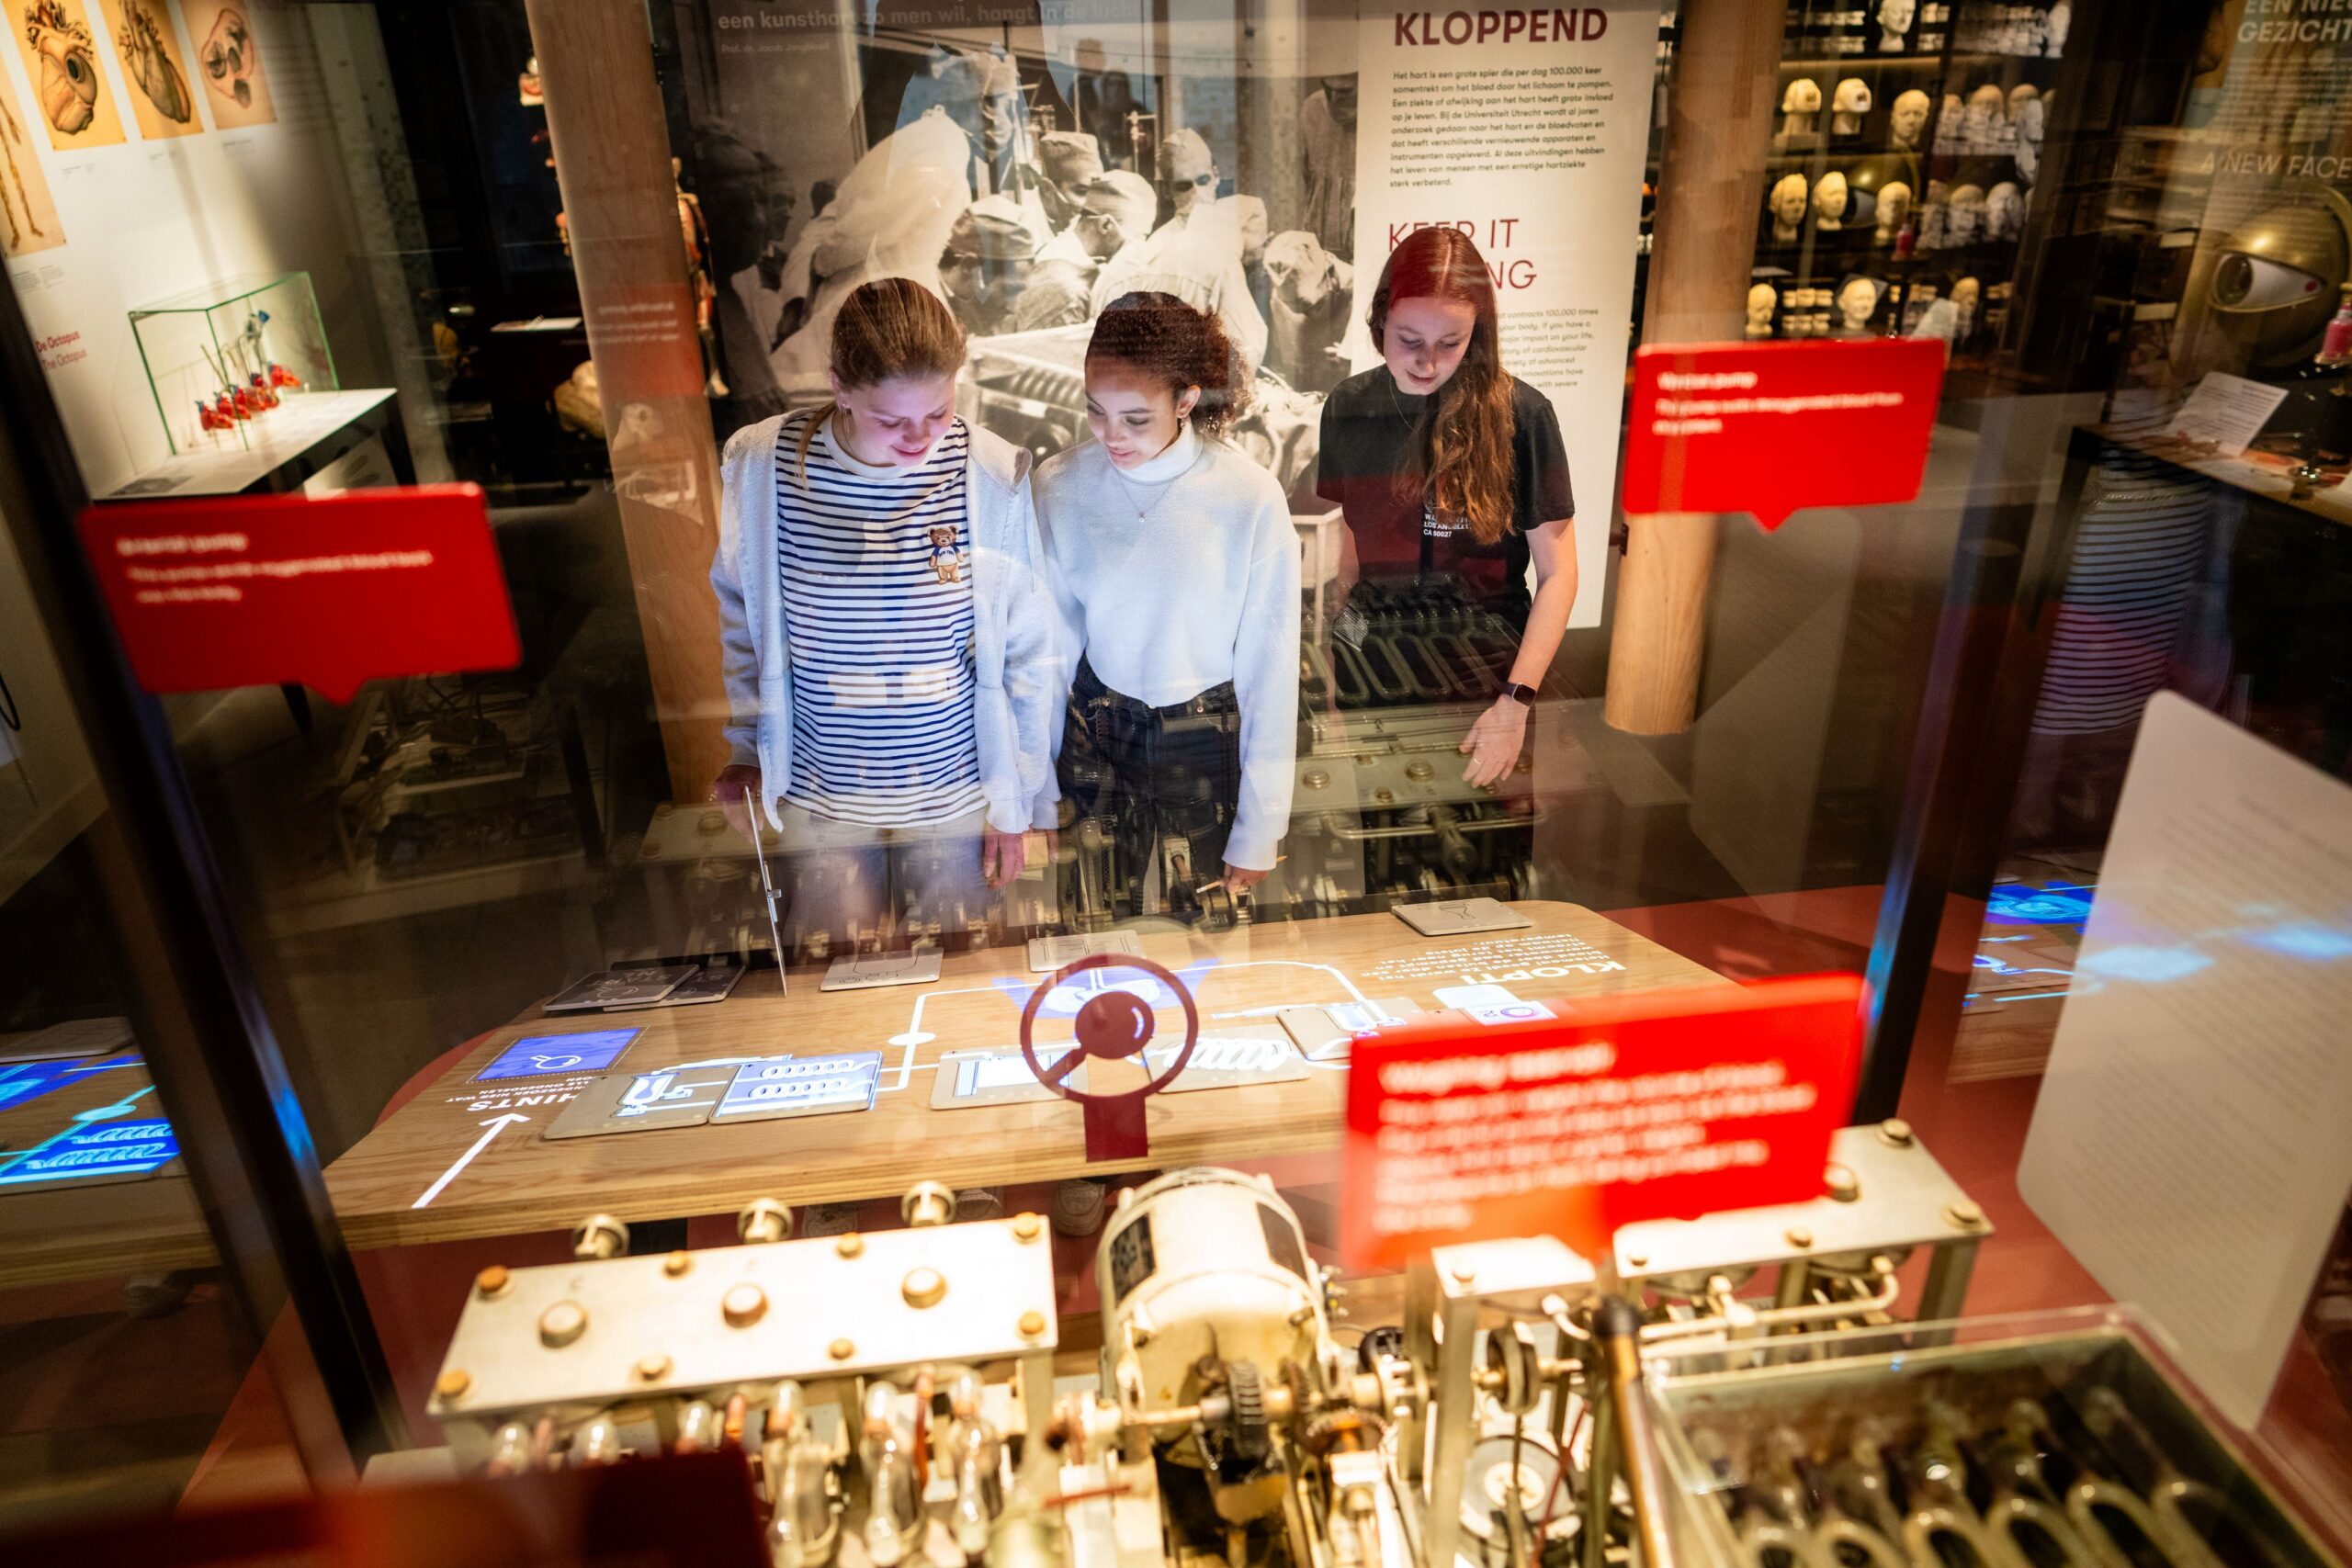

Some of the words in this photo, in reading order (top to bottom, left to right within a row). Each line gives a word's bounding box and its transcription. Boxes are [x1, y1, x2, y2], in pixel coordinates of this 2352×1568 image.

[718, 15, 754, 28] een
[890, 11, 933, 25] men
[939, 7, 972, 25] wil,
[977, 5, 1036, 23] hangt
[1395, 8, 1608, 46] KLOPPEND
[2237, 18, 2352, 43] GEZICHT
[1455, 70, 1476, 79] grote
[1479, 69, 1498, 79] spier
[1532, 68, 1547, 77] dag
[1550, 67, 1583, 75] 100.000
[1577, 81, 1611, 89] pompen.
[1409, 98, 1432, 107] ziekte
[1446, 97, 1483, 107] afwijking
[1561, 95, 1581, 103] grote
[1405, 113, 1412, 121] je
[1441, 111, 1450, 120] Bij
[1464, 109, 1509, 118] Universiteit
[1511, 108, 1541, 117] Utrecht
[1578, 107, 1599, 116] jaren
[1392, 126, 1432, 134] onderzoek
[1436, 125, 1466, 134] gedaan
[1548, 120, 1592, 129] bloedvaten
[1486, 135, 1540, 144] vernieuwende
[1543, 135, 1584, 143] apparaten
[1391, 152, 1443, 161] instrumenten
[1524, 148, 1574, 157] uitvindingen
[1406, 165, 1426, 174] leven
[1512, 162, 1544, 171] ernstige
[2223, 153, 2282, 175] NEW
[2287, 155, 2352, 179] FACE
[1388, 220, 1476, 253] KP
[1490, 219, 1519, 249] IT
[47, 330, 80, 348] Octopus
[56, 348, 87, 367] Octopus
[1535, 955, 1610, 965] Helemaal
[1461, 960, 1627, 986] KLOPT!
[479, 1083, 564, 1094] ONDERDELEN
[513, 1086, 585, 1096] NDERZOEK
[467, 1092, 581, 1111] HINTS
